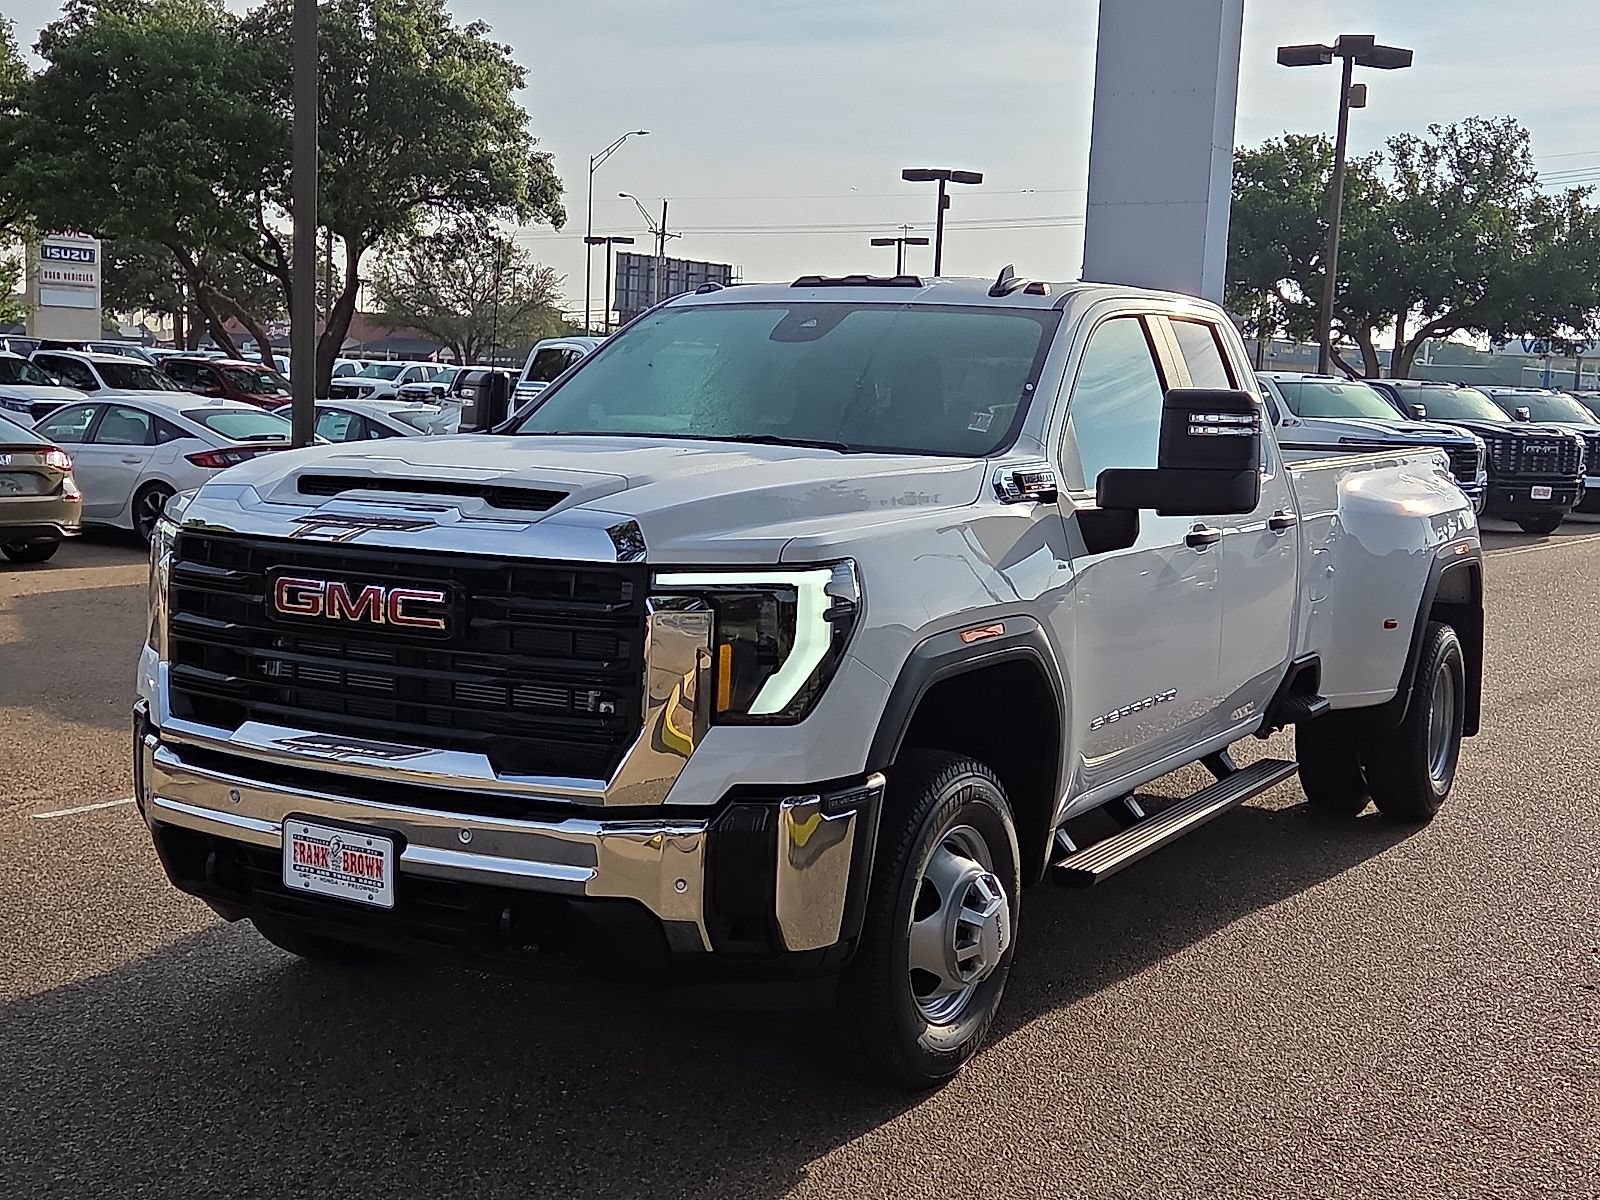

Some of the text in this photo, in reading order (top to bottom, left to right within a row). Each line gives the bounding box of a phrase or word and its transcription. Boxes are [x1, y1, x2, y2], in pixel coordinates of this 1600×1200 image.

[46, 246, 91, 261] ISUZU
[43, 270, 95, 282] USED VEHICLES
[274, 576, 446, 631] GMC
[293, 841, 384, 881] FRANK BROWN
[295, 865, 315, 874] AUTO
[332, 872, 356, 882] TRUCK
[319, 876, 339, 886] HONDA
